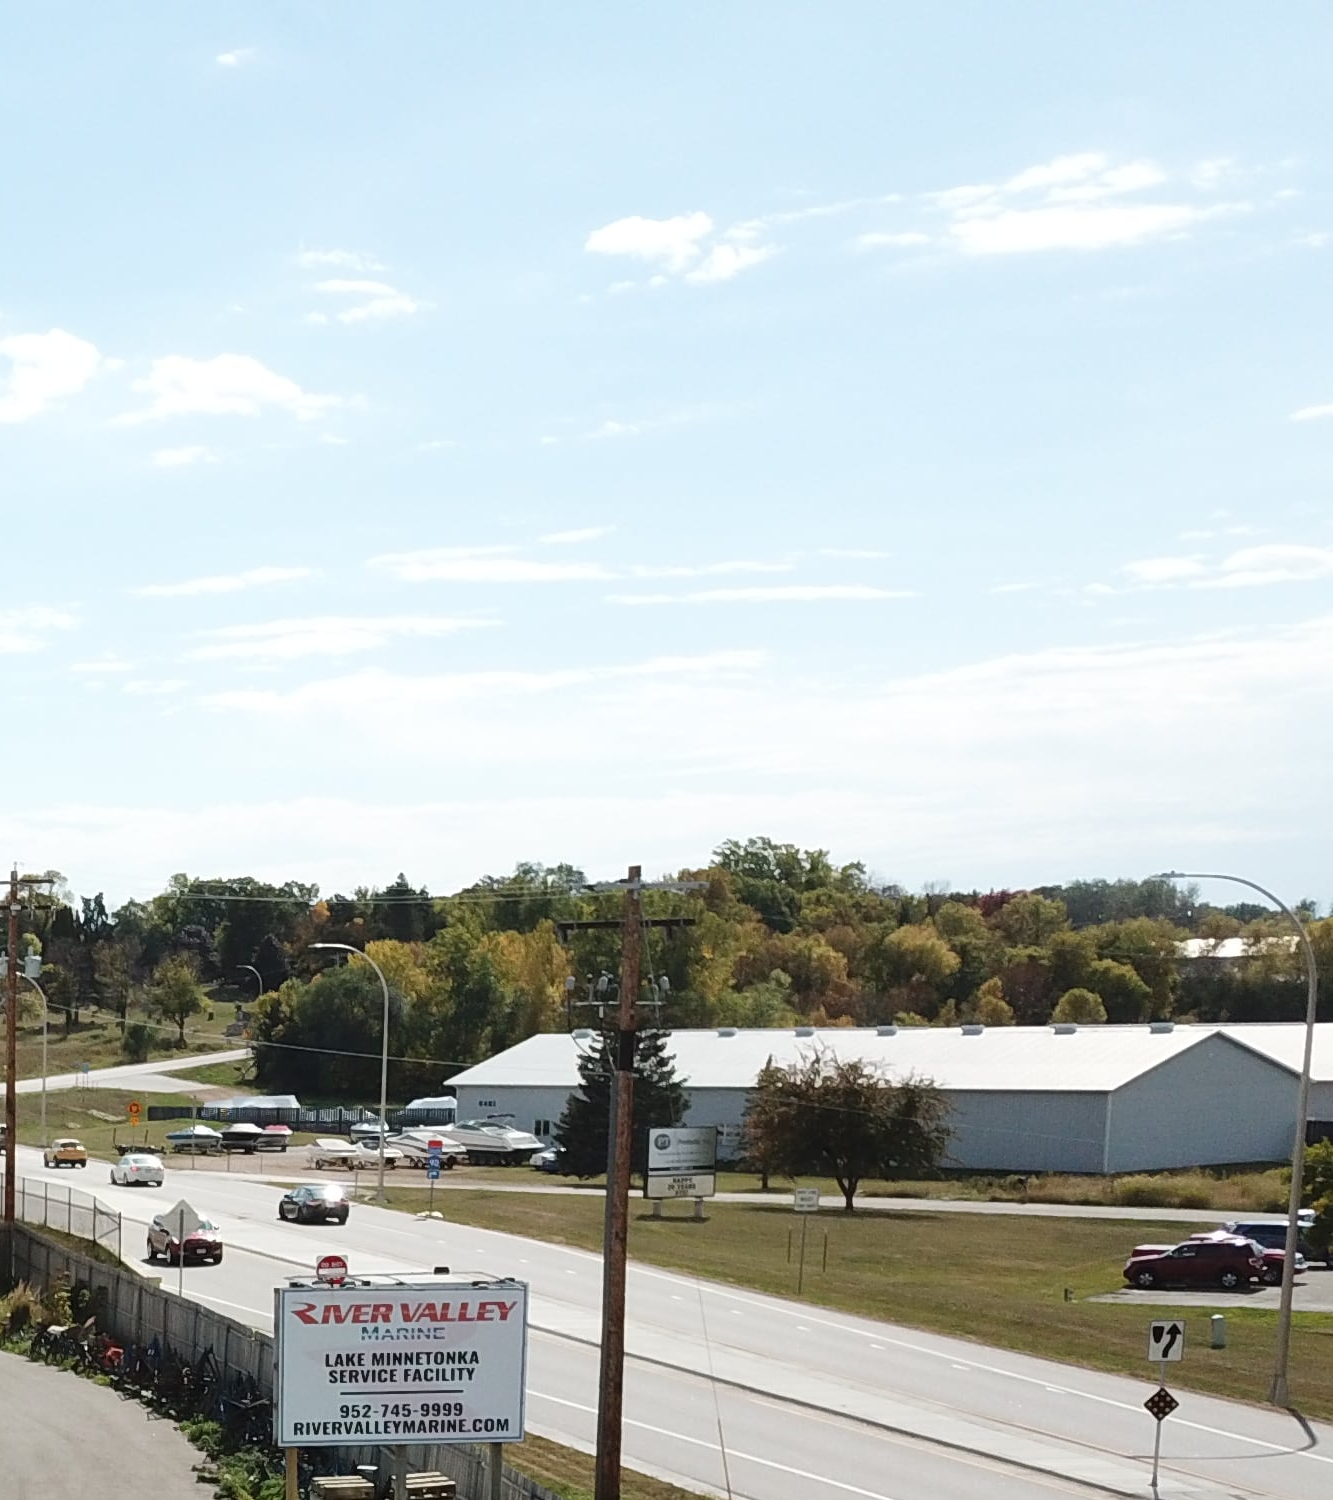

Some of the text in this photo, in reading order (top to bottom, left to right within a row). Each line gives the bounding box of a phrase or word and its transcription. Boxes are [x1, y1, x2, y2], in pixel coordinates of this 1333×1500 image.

[290, 1301, 518, 1324] RIVER VALLEY
[361, 1326, 446, 1341] MARINE
[325, 1351, 480, 1367] LAKE MINNETONKA
[328, 1367, 476, 1384] SERVICE FACILITY
[339, 1402, 464, 1419] 952-745-9999
[293, 1418, 509, 1436] RIVERVALLEYMARINE.COM
